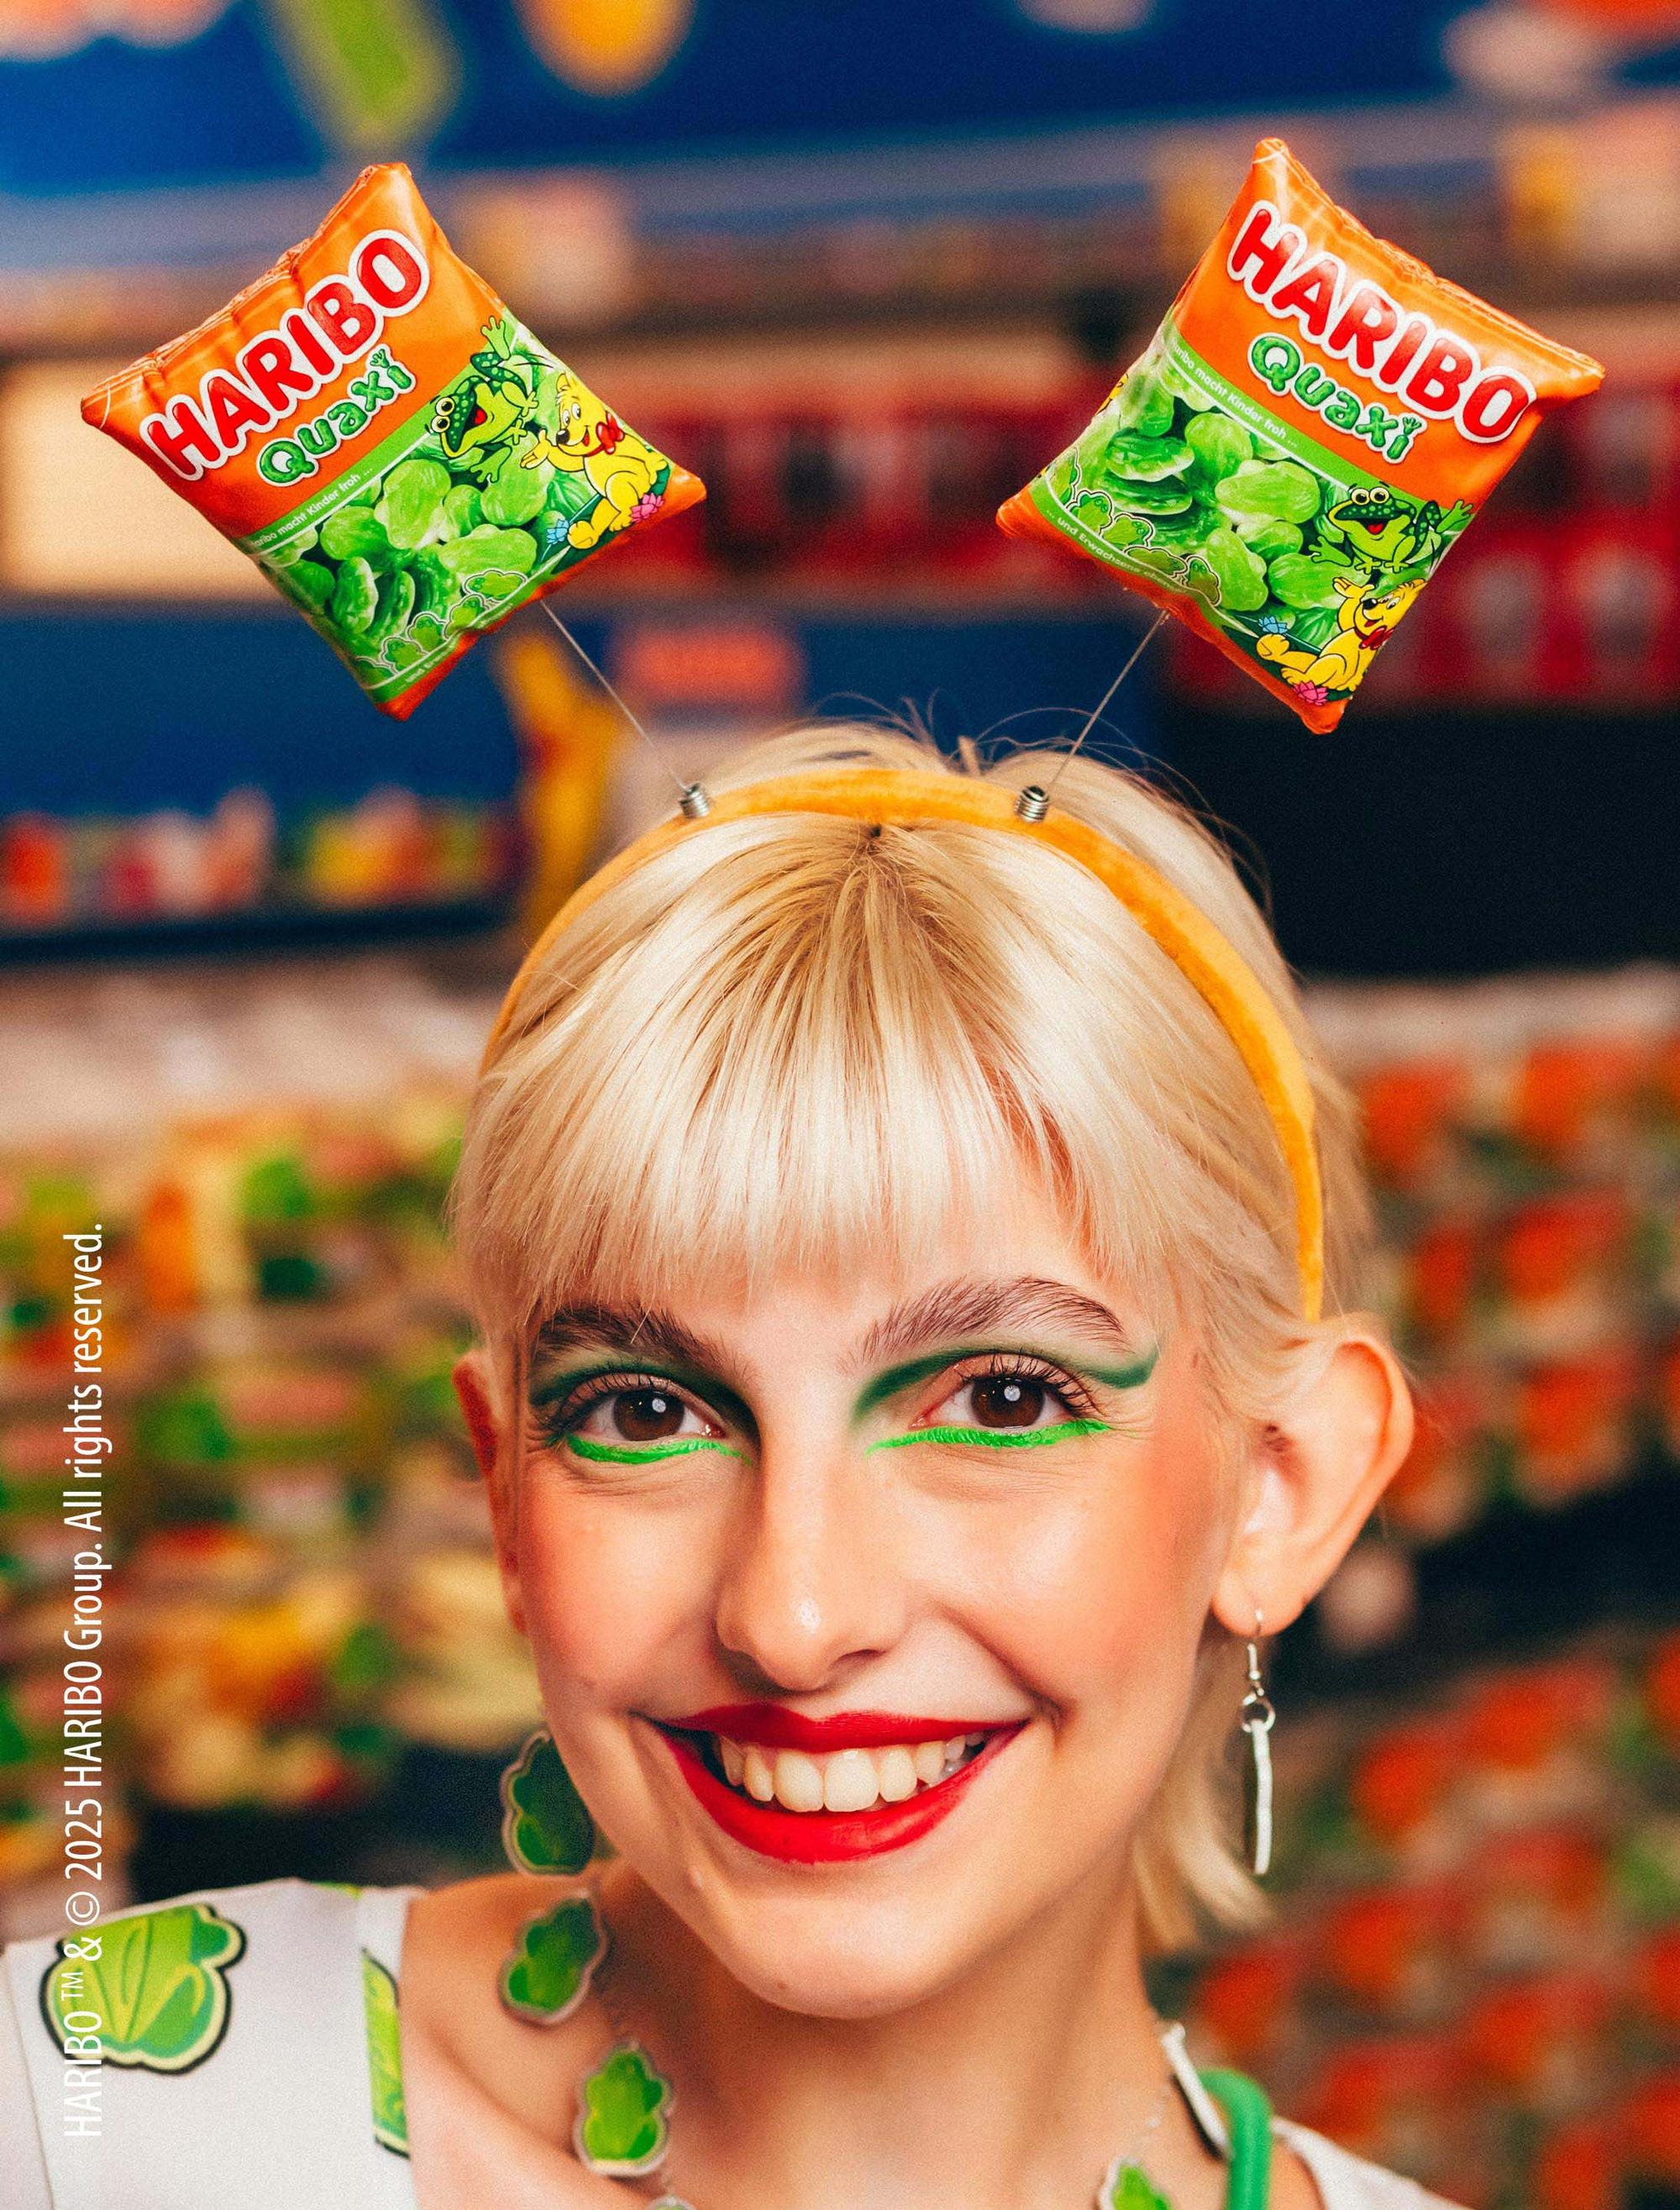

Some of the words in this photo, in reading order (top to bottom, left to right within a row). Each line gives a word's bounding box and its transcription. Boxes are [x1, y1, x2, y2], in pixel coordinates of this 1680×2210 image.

[139, 229, 429, 480] HARIBO
[1227, 200, 1536, 443] HARIBO
[256, 344, 417, 486] Quaxi
[1194, 367, 1228, 397] macht
[1227, 393, 1263, 423] Kinder
[1263, 418, 1287, 439] froh
[1248, 333, 1427, 464] Quaxi
[277, 512, 307, 535] macht
[307, 489, 339, 516] Kinder
[339, 474, 360, 492] froh
[1058, 517, 1079, 535] und
